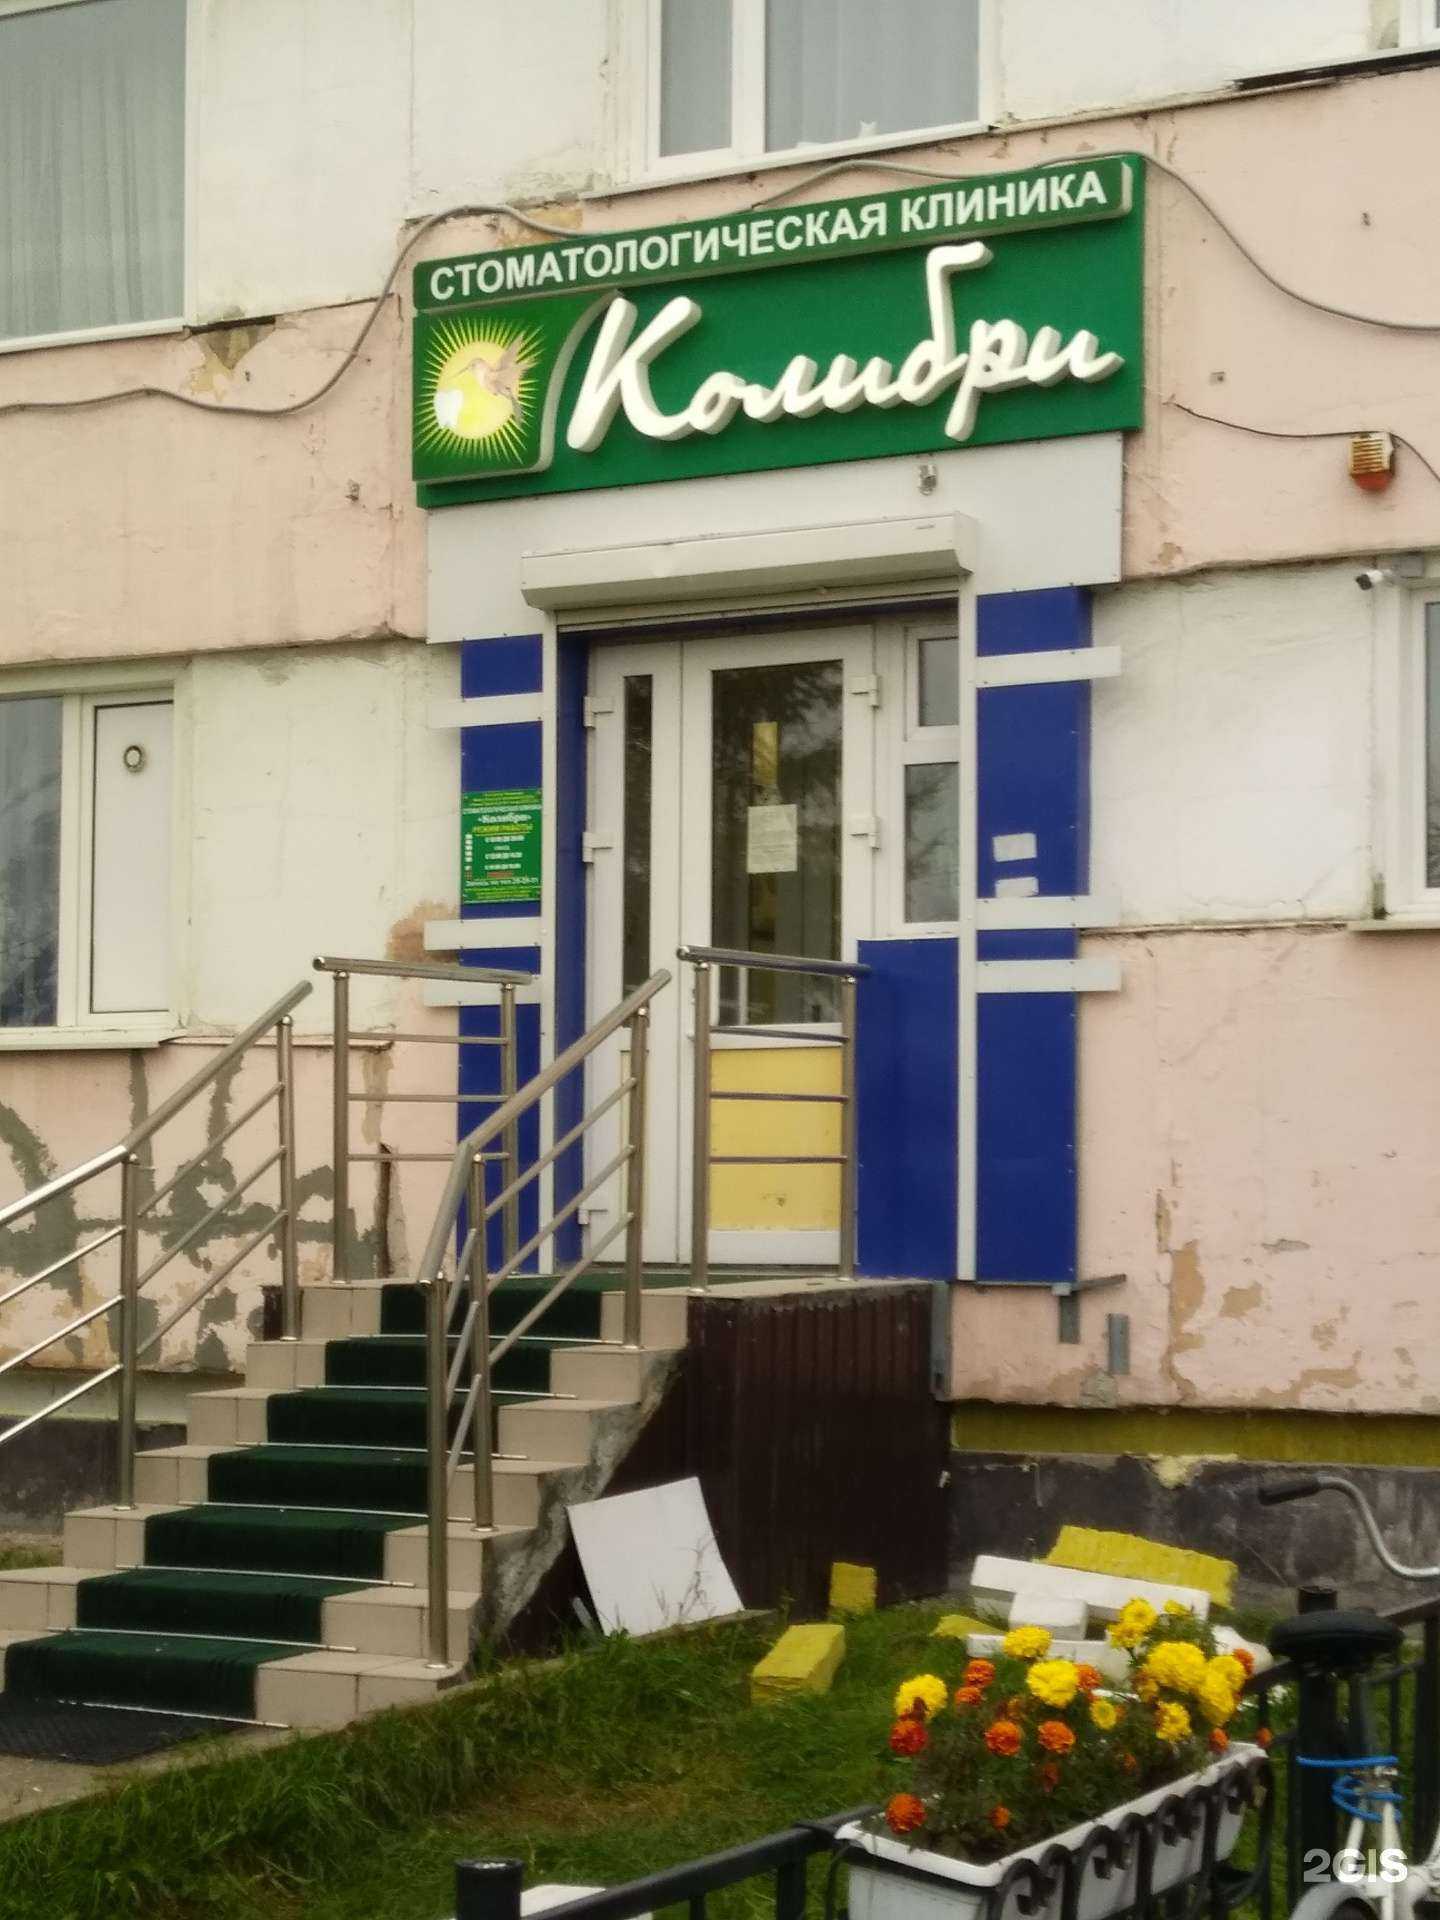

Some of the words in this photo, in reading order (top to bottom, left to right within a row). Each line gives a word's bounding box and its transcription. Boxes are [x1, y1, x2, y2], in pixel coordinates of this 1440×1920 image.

[429, 202, 888, 301] СТОМАТОЛОГИЧЕСКАЯ
[900, 170, 1107, 235] КЛИНИКА
[566, 240, 1126, 453] Колибри
